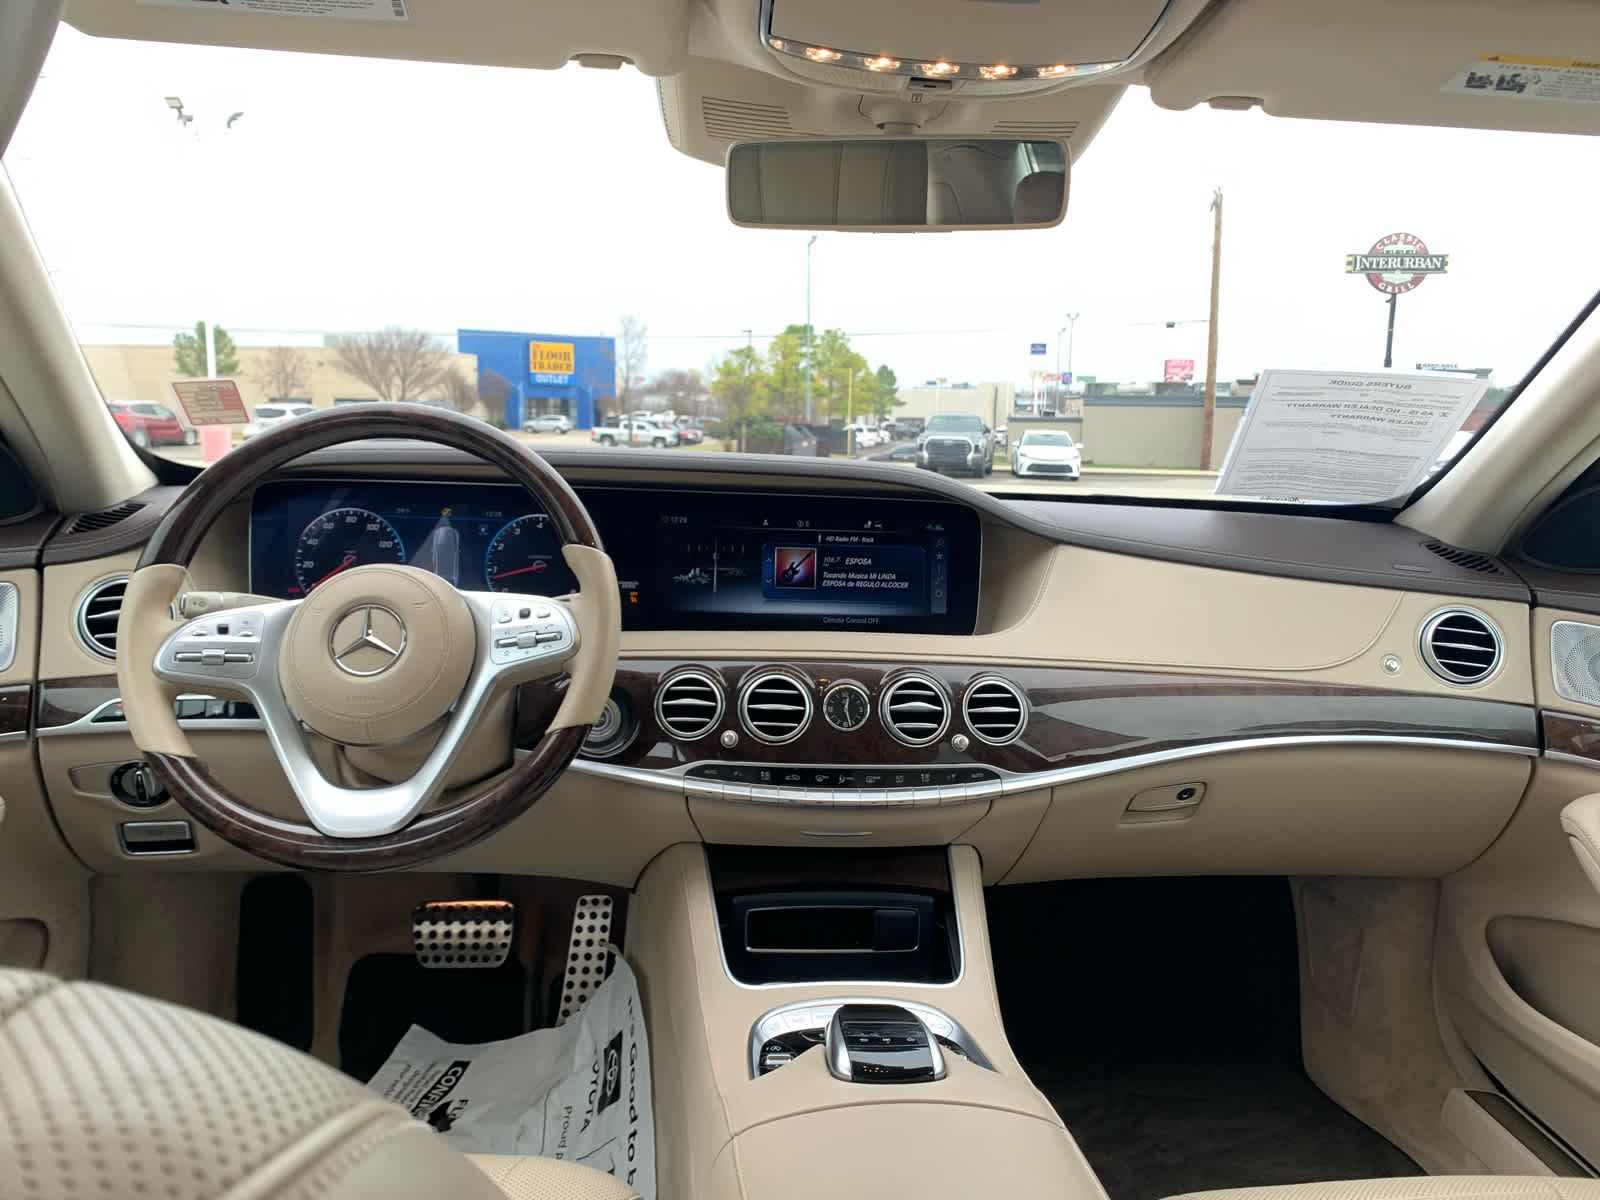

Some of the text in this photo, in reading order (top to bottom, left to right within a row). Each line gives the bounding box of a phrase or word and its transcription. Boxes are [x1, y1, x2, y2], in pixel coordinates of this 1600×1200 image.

[1376, 233, 1424, 250] CLASSIC
[1354, 255, 1443, 272] INTERURBAN
[1378, 281, 1415, 293] GRILL
[532, 350, 571, 361] FLOOR
[532, 361, 573, 372] TRADER
[535, 374, 569, 385] OUTLET
[498, 543, 505, 551] 2
[845, 557, 872, 566] ESPOSA
[822, 571, 847, 580] Tocando
[822, 580, 846, 588] ESPOSA
[855, 581, 880, 589] REGULO
[879, 581, 910, 589] ALCOCER
[823, 616, 881, 625] Climate Control OFF
[628, 1041, 638, 1125] Good
[557, 1104, 573, 1150] Proud
[627, 1128, 638, 1163] to
